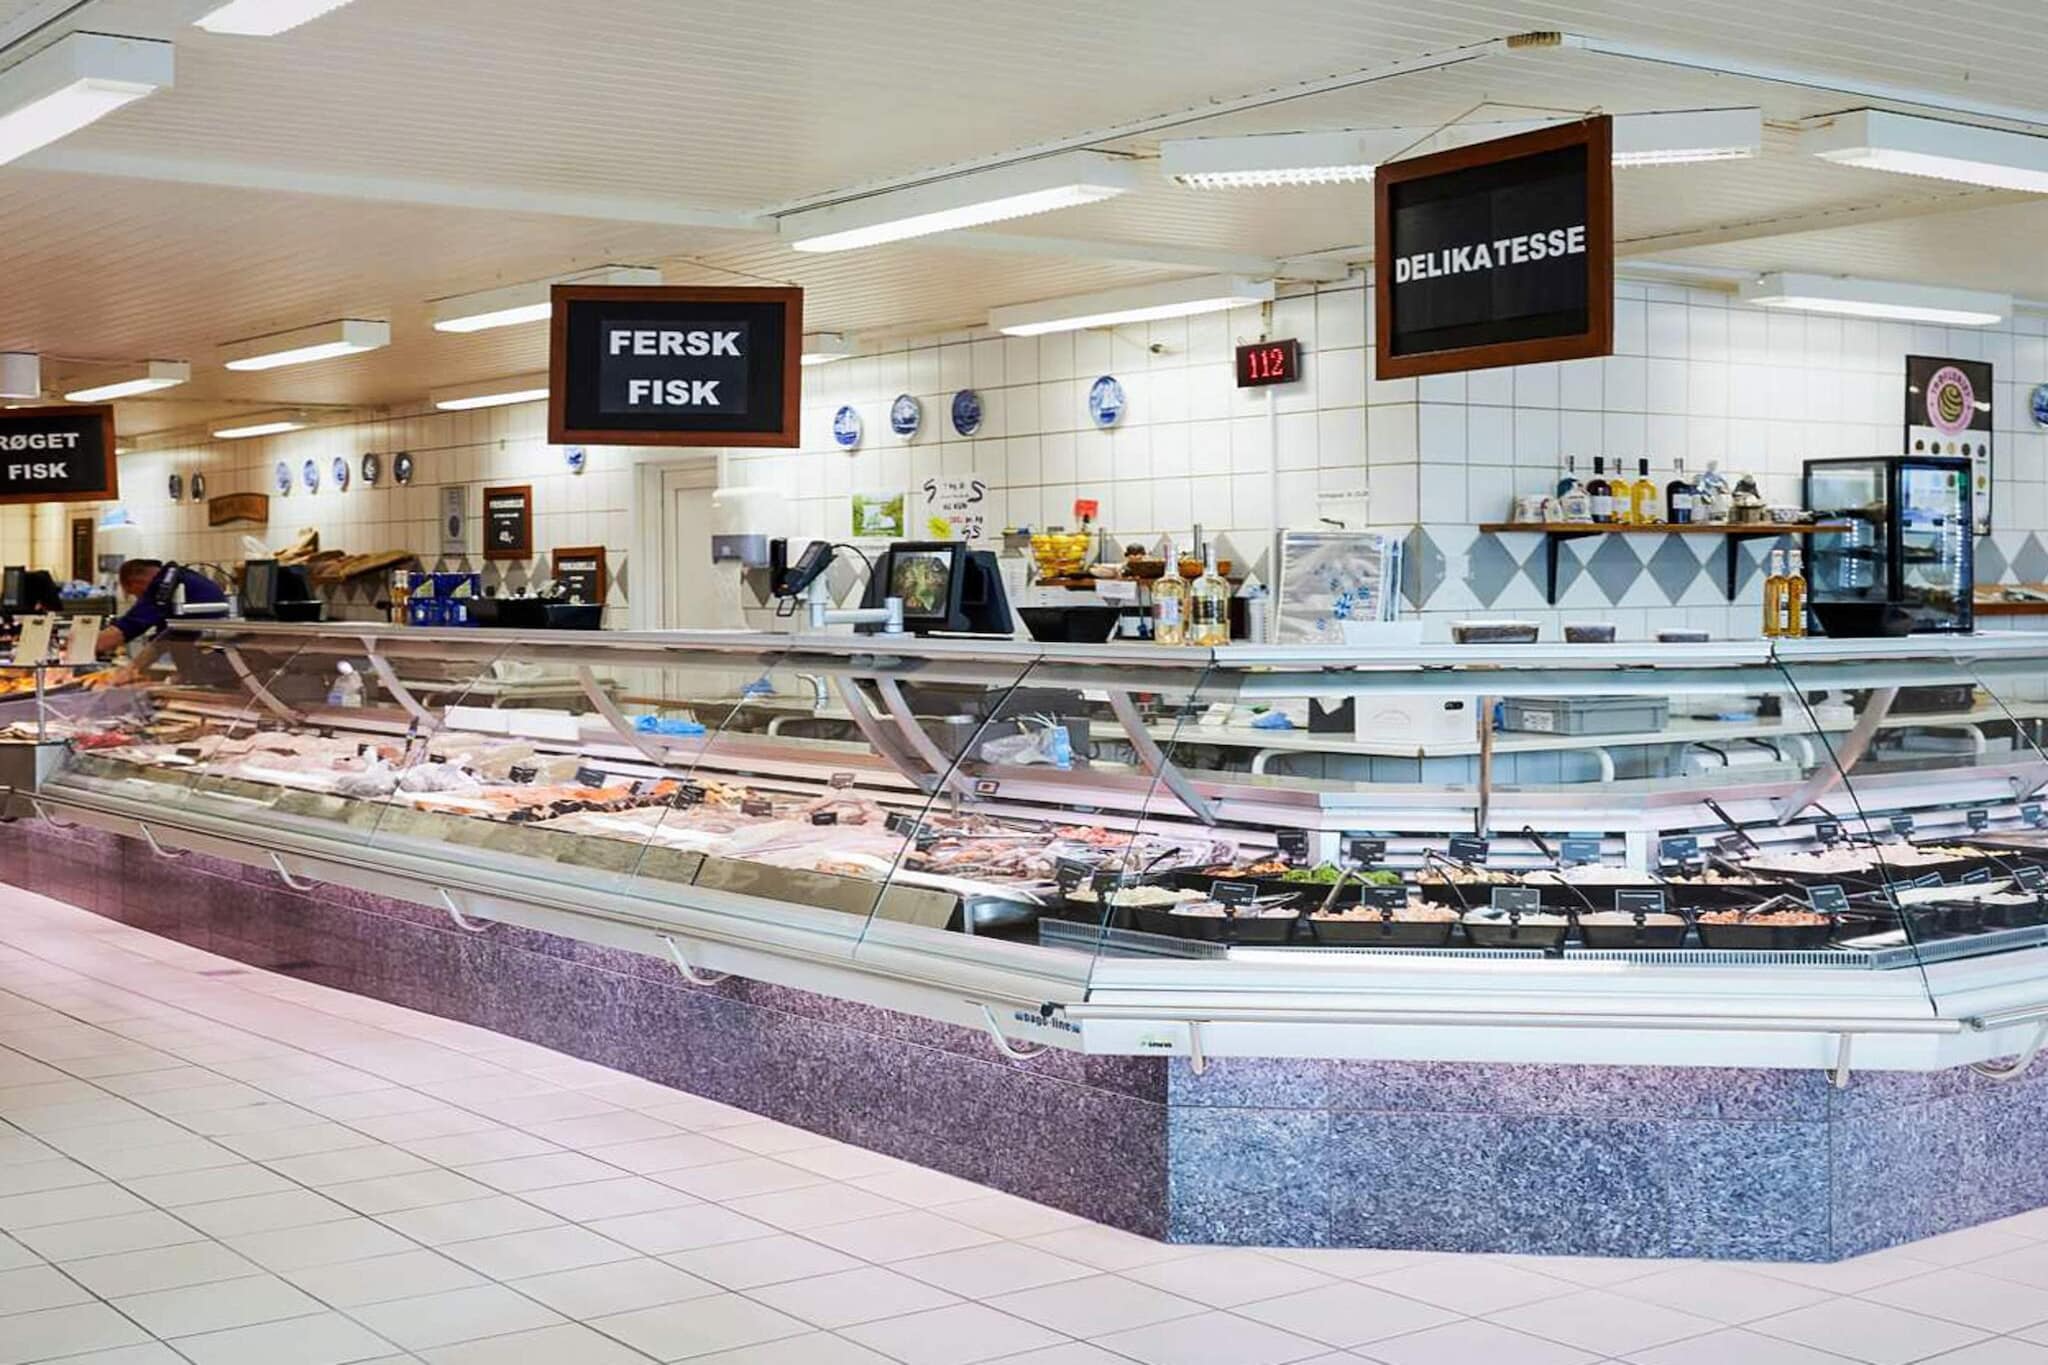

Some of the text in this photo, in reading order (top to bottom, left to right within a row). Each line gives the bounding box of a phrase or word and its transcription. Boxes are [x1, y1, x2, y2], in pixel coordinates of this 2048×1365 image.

[1396, 225, 1586, 283] DELIKATESSE
[609, 330, 742, 356] FERSK
[1249, 348, 1284, 379] 112
[628, 379, 721, 406] FISK
[0, 433, 80, 451] RØGET
[8, 462, 69, 480] FISK
